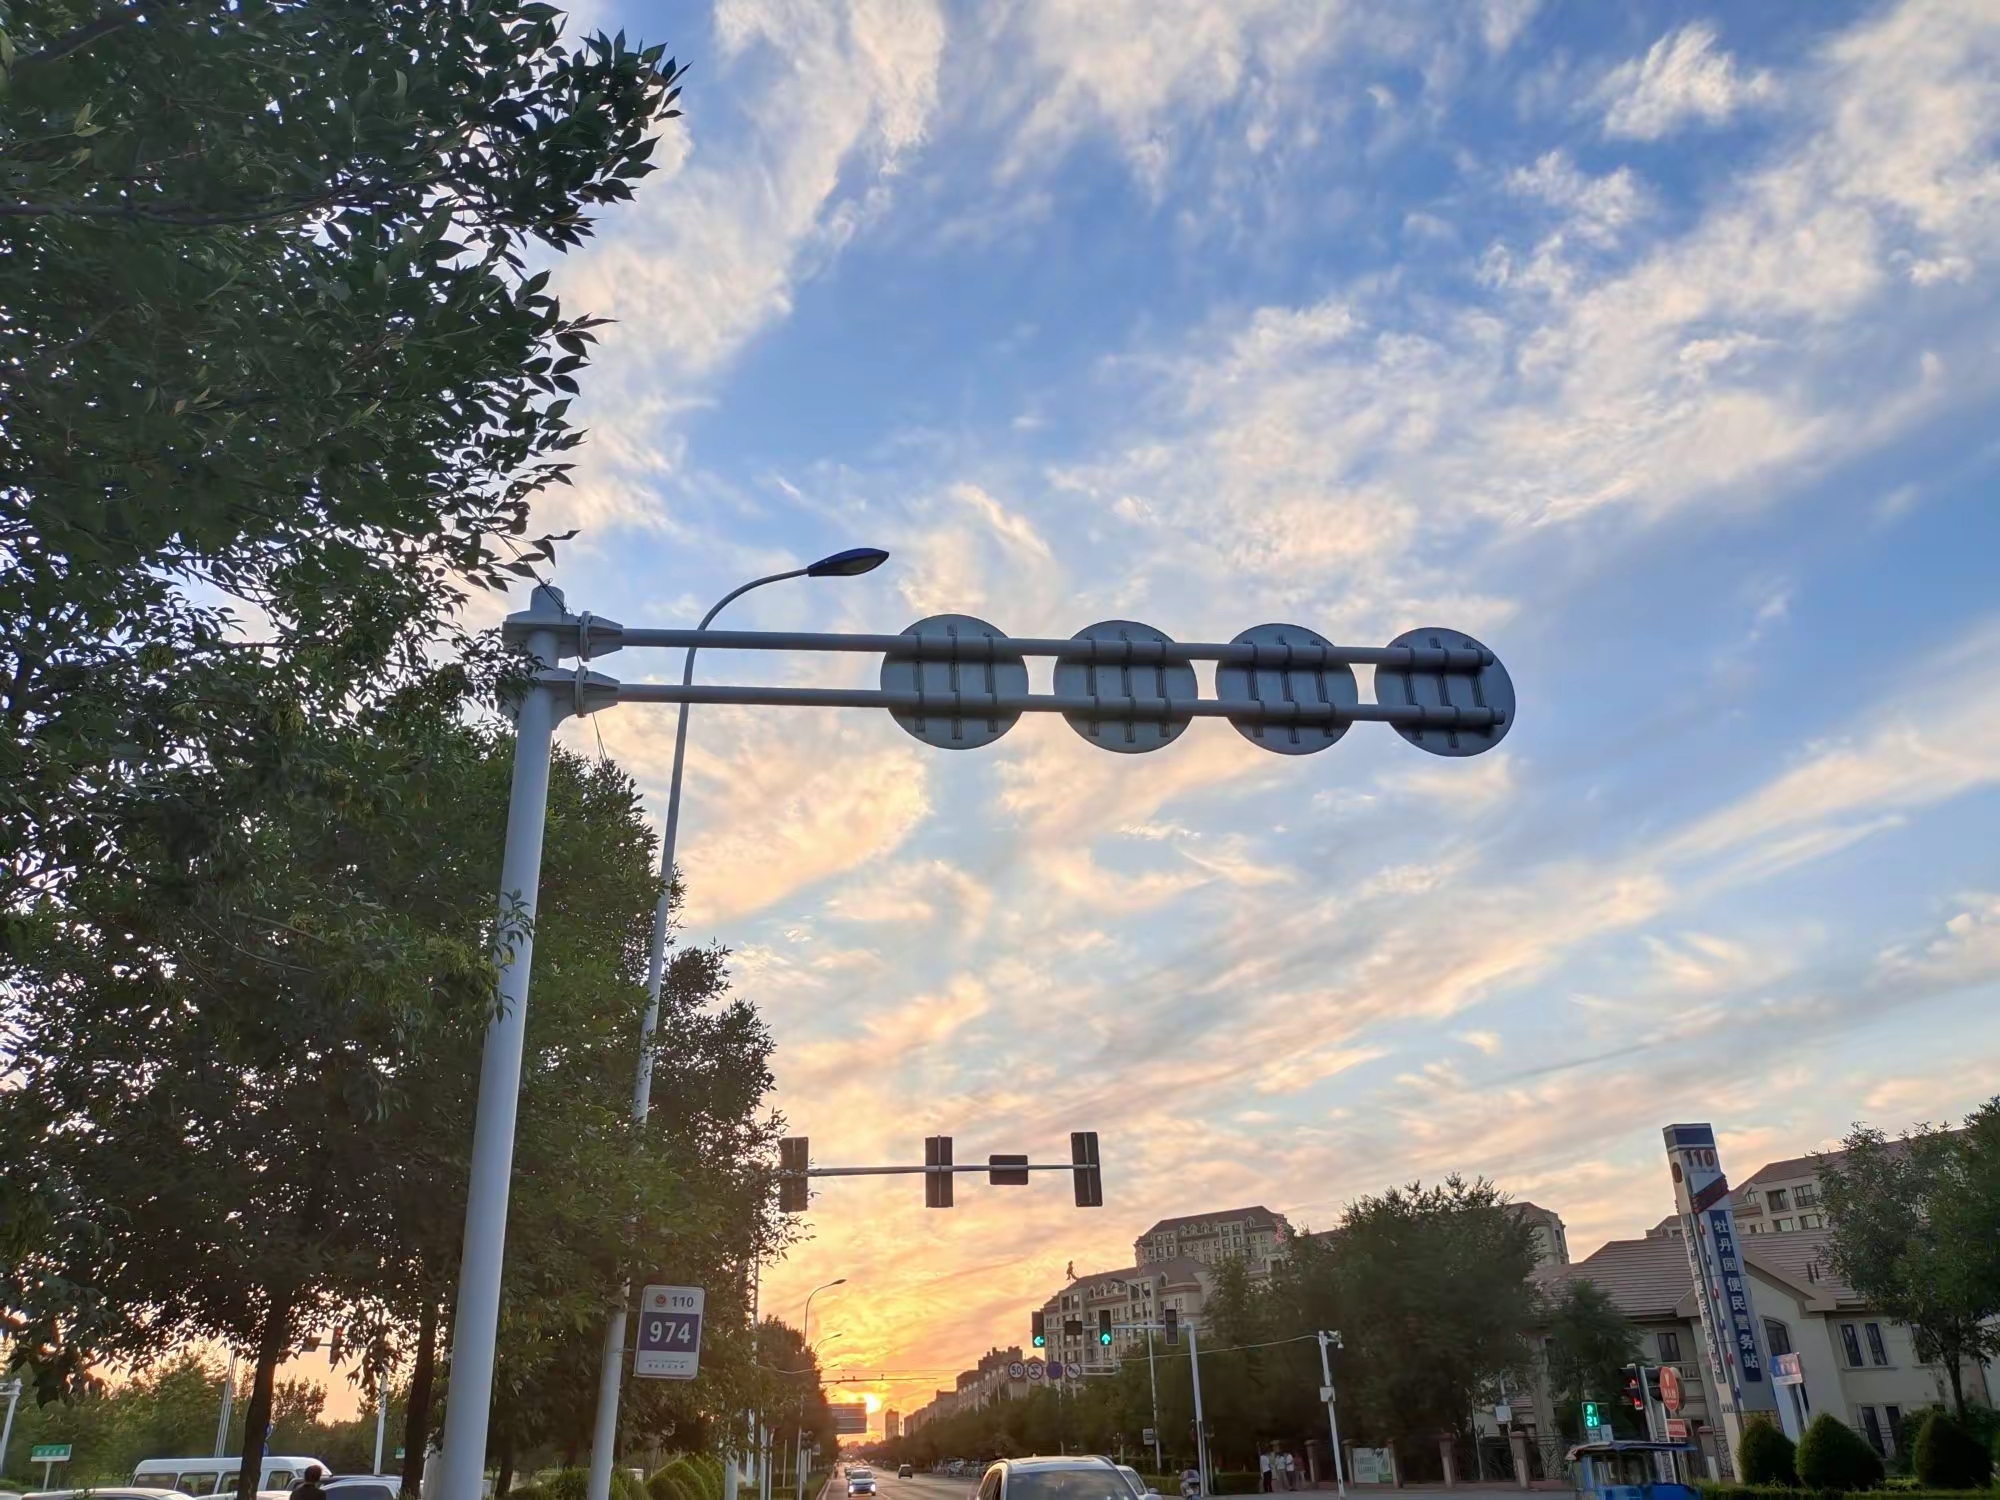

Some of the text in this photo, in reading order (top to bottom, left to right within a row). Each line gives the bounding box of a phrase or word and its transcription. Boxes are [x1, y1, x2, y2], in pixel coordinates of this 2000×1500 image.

[1684, 1150, 1714, 1167] 110
[672, 1296, 693, 1307] 110
[1714, 1219, 1760, 1369] 牡丹园便民警务站
[650, 1321, 690, 1343] 974
[1011, 1366, 1021, 1375] 50
